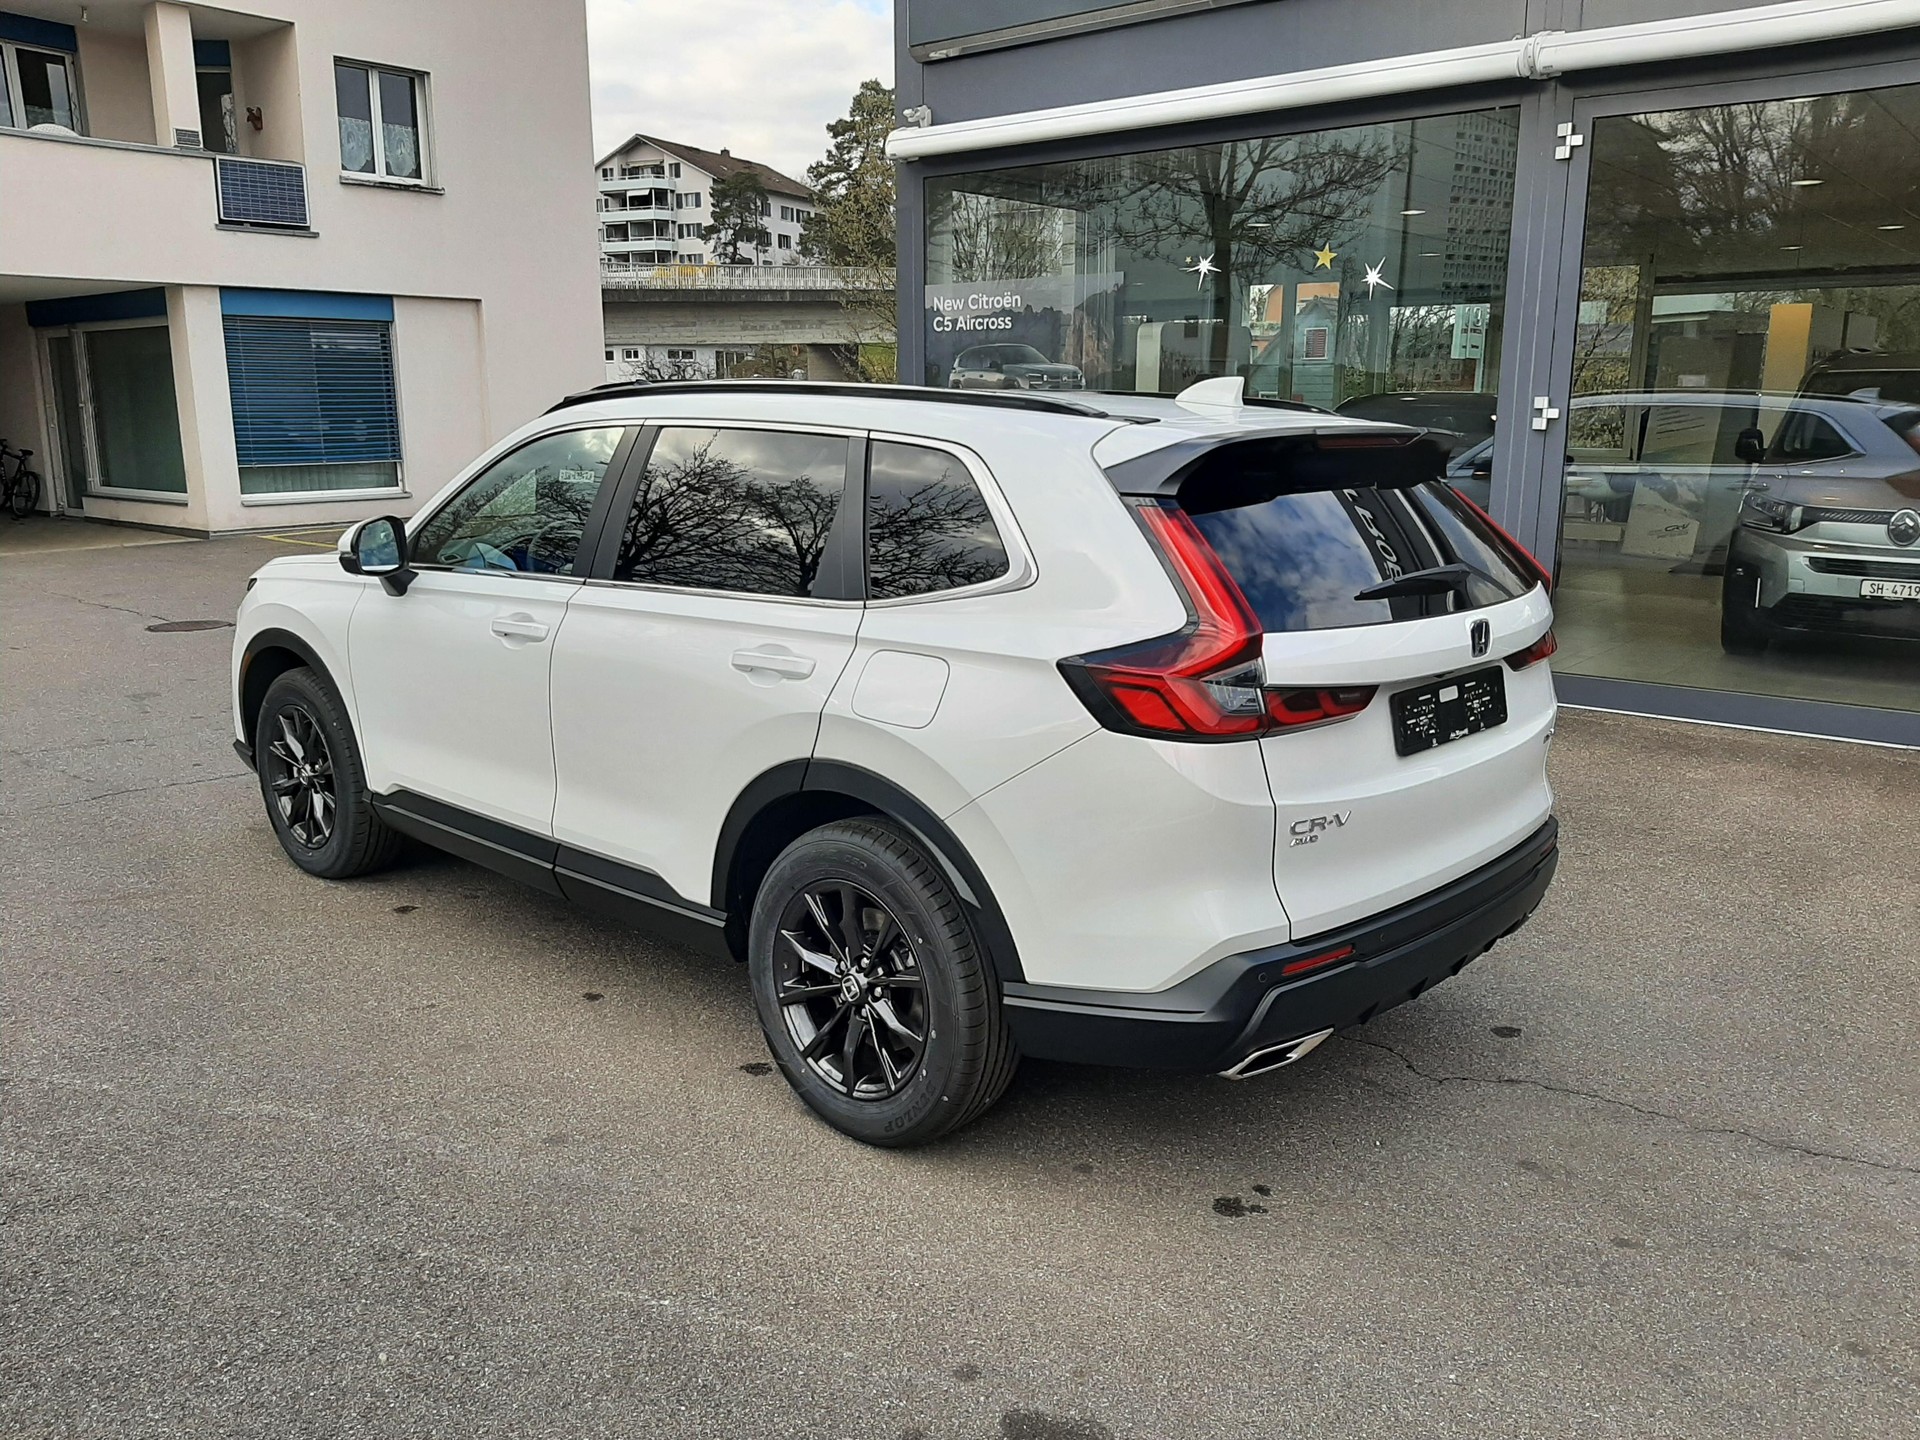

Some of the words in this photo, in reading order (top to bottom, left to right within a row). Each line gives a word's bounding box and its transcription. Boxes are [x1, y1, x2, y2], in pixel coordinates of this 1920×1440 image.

[933, 296, 964, 312] New
[968, 291, 1021, 310] Citroën
[933, 316, 953, 332] C5
[956, 315, 1012, 331] Aircross
[1289, 810, 1352, 836] CR-V
